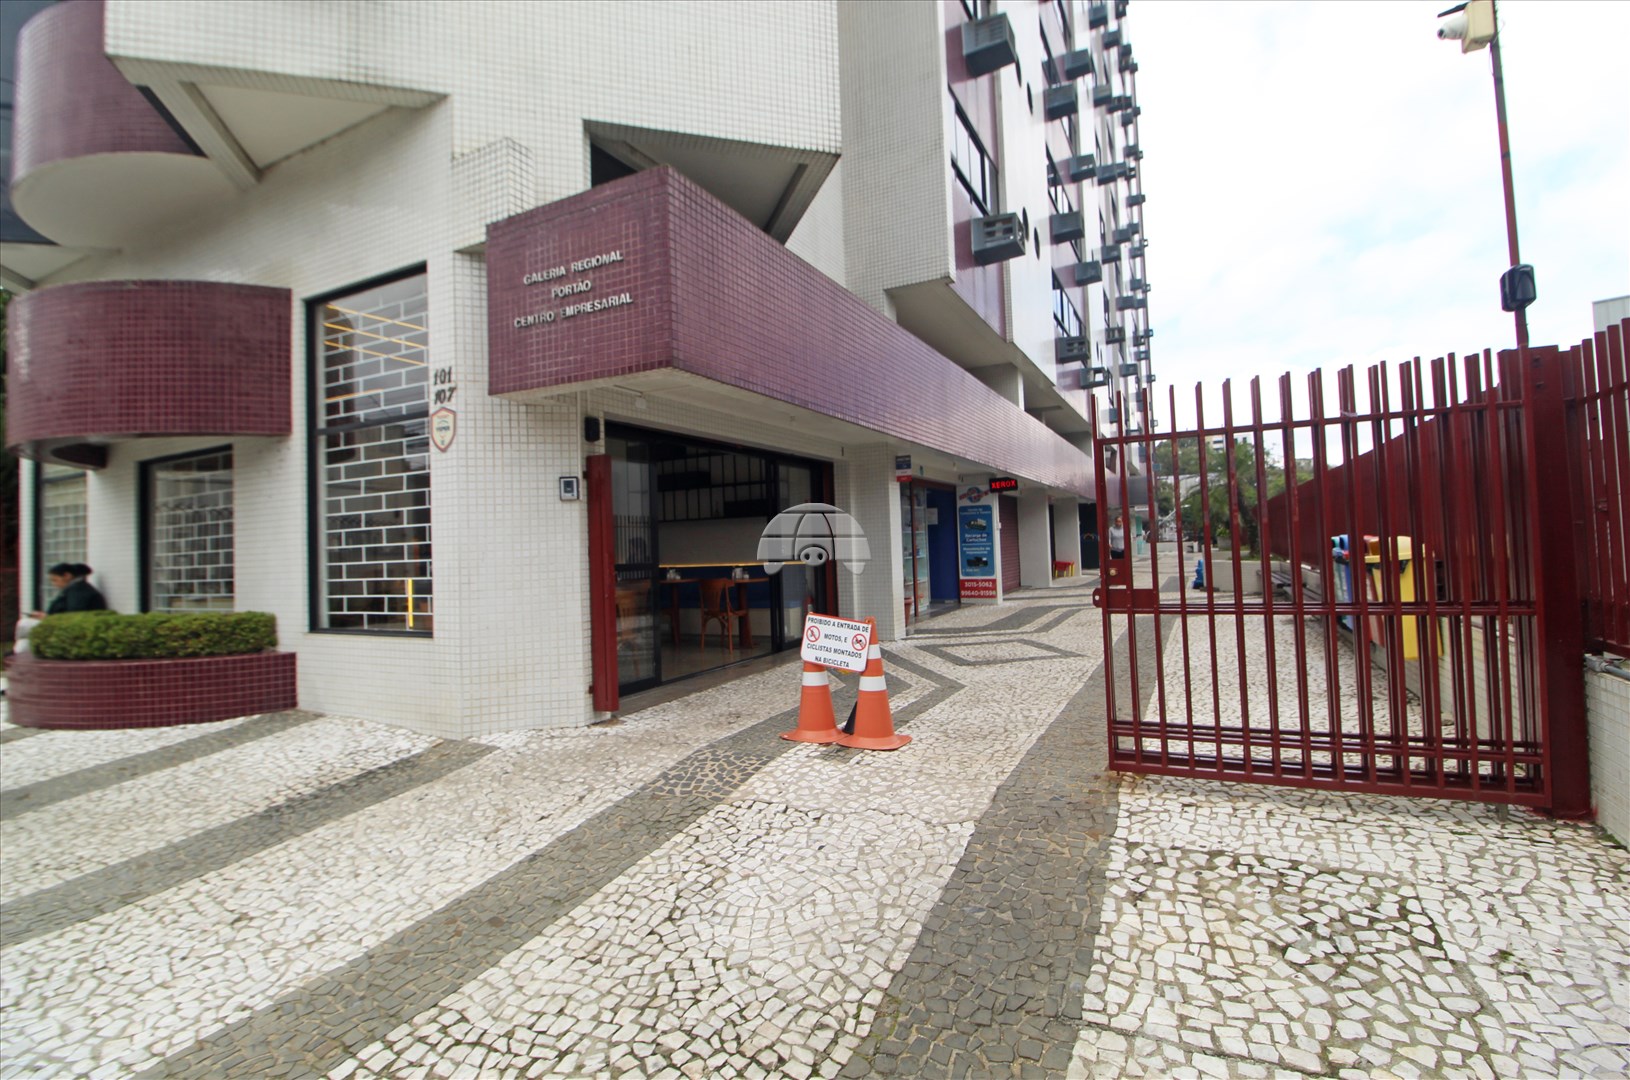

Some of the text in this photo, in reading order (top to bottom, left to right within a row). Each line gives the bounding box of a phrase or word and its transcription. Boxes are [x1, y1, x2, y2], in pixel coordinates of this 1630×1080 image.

[523, 250, 624, 286] GALERIA REGIONAL
[552, 279, 592, 298] PORTÃO
[514, 292, 633, 328] CENTRO EMPRESARIAL
[434, 366, 452, 386] 101
[434, 387, 457, 405] 107
[991, 480, 1016, 489] XEROX
[807, 617, 831, 626] PROIBIDO
[837, 622, 861, 631] ENTRADA
[824, 633, 843, 643] MOTOS,
[806, 644, 862, 659] CICLISTAS MONTADOS
[823, 658, 849, 667] BICICLETA
